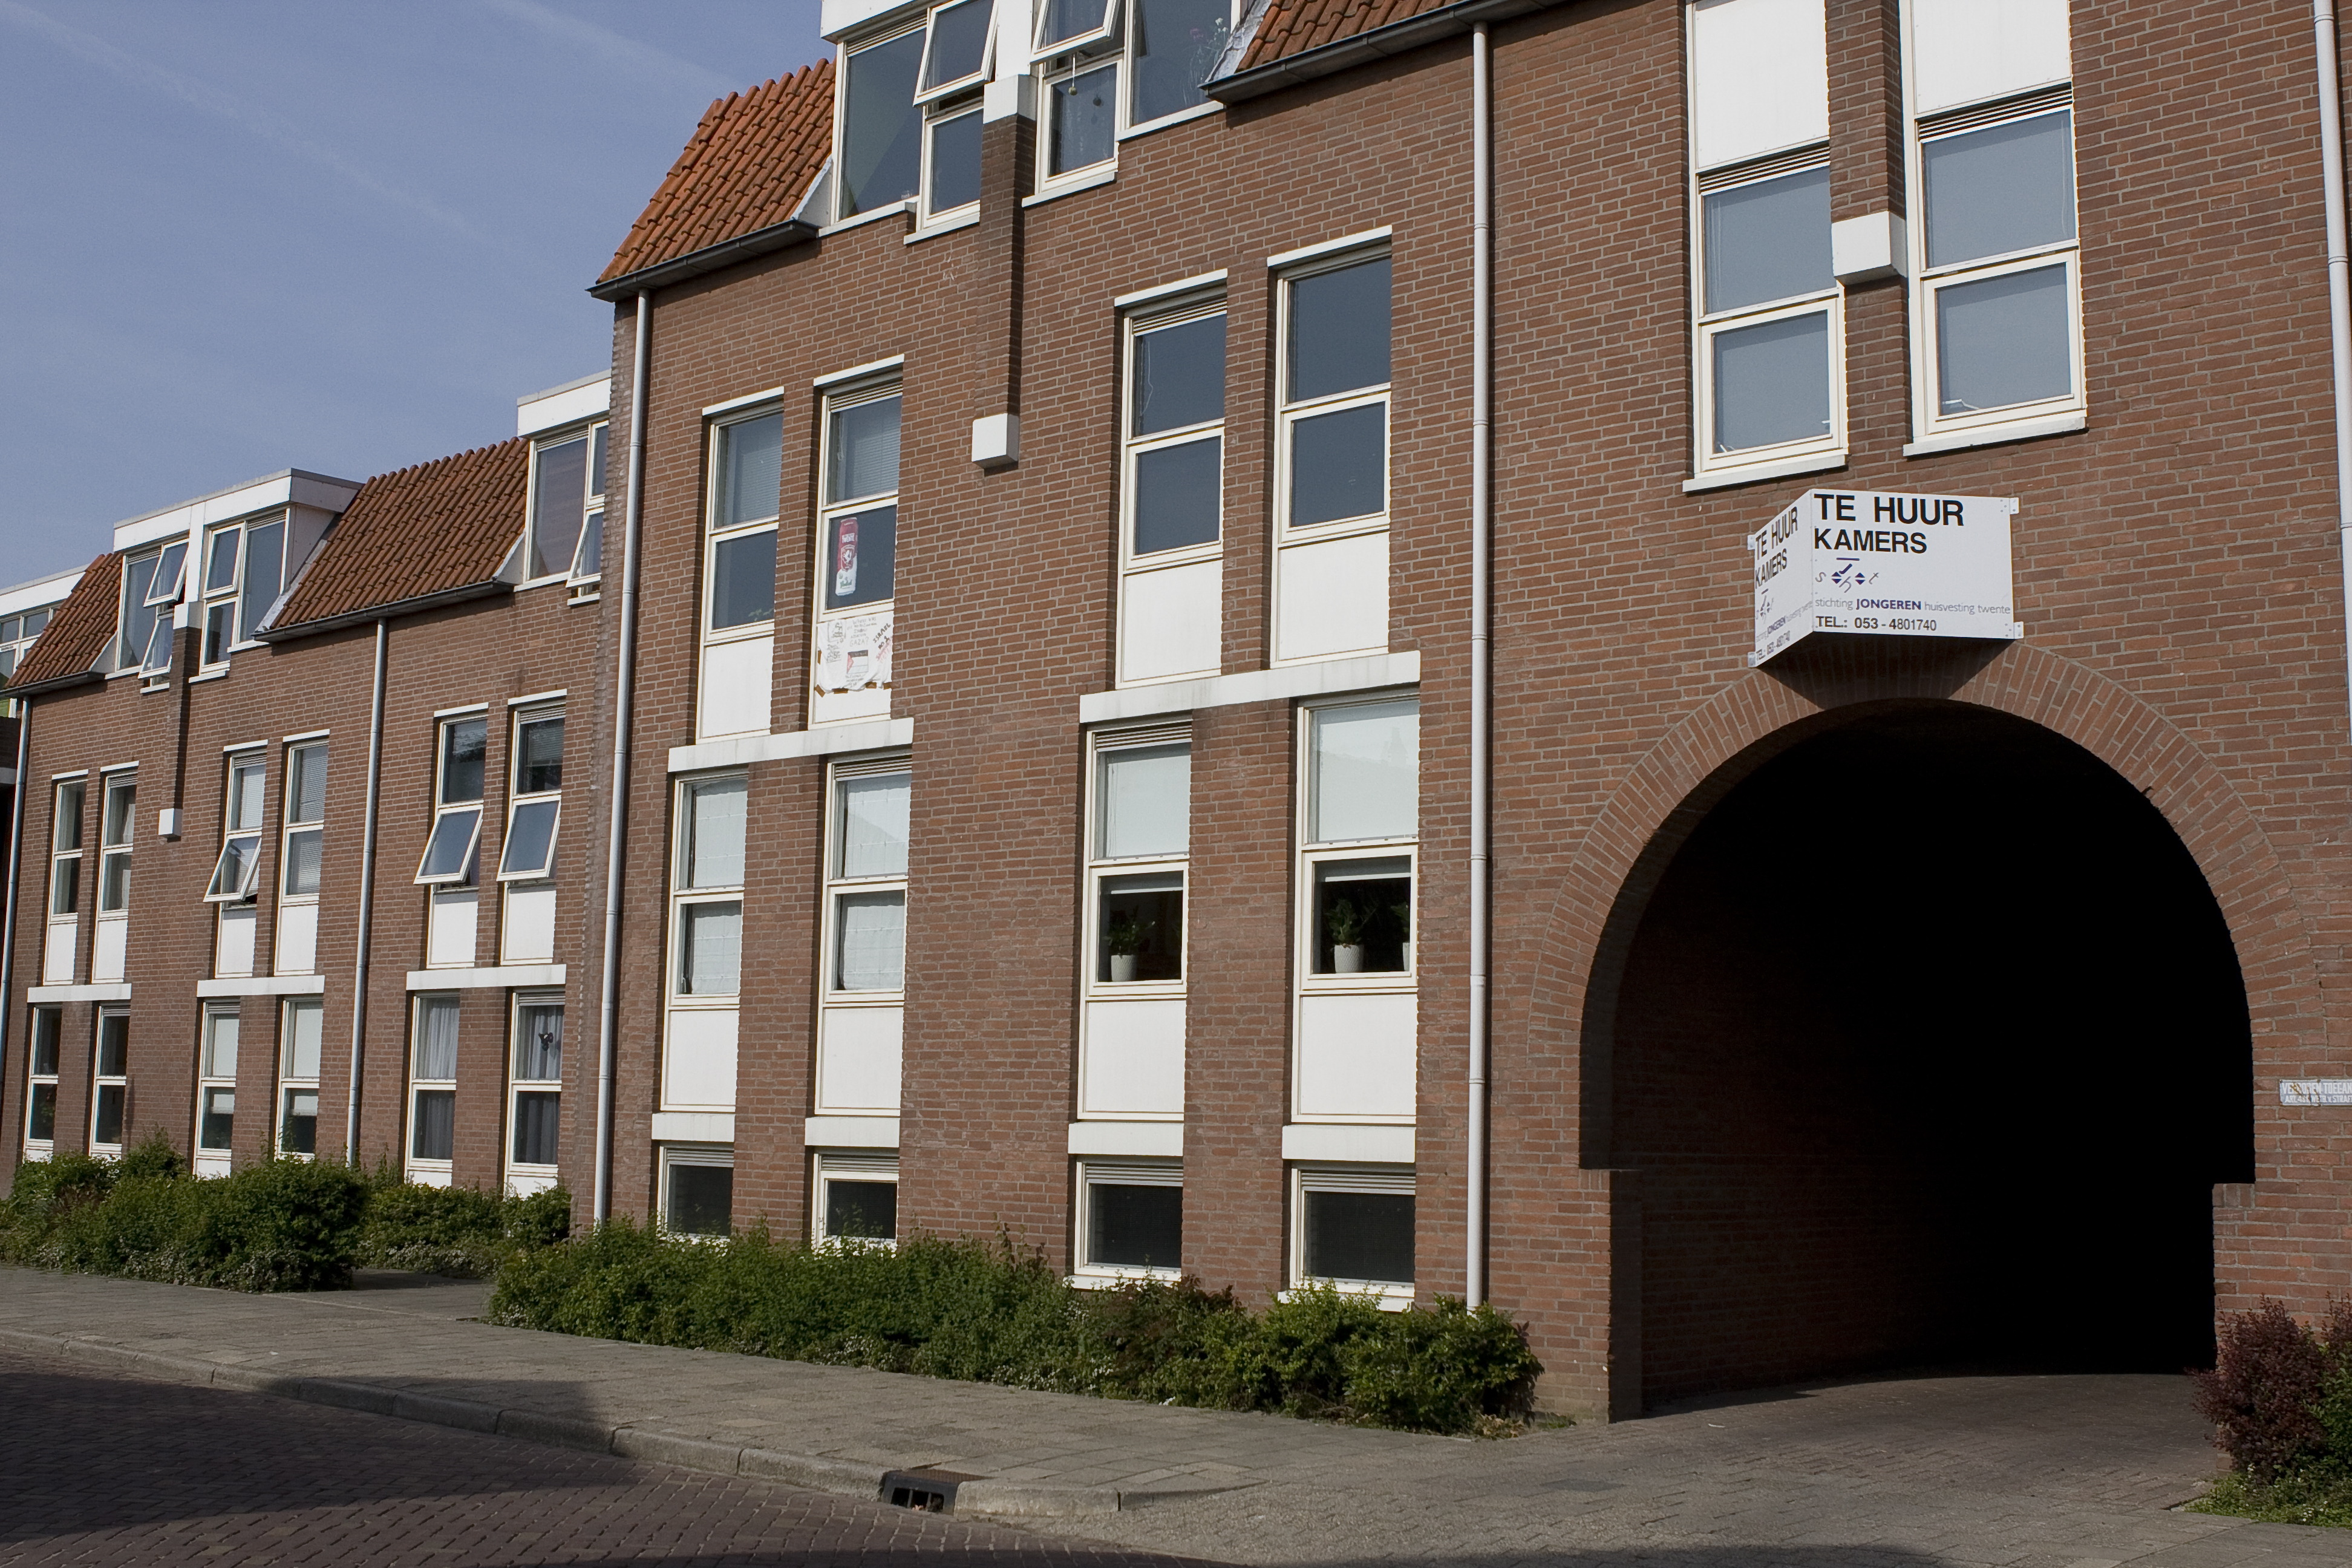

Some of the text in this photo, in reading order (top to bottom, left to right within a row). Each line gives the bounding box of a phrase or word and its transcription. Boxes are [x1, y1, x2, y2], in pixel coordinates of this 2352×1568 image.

[1814, 494, 1964, 526] TE HUUR
[1756, 506, 1798, 560] TE HUUR
[1814, 528, 1927, 554] KAMERS
[1755, 548, 1787, 589] KAMERS
[1815, 597, 2011, 615] stichting JONGEREN huisvesting twente
[1854, 617, 1879, 629] 053
[1889, 618, 1936, 631] 4801740
[849, 636, 869, 647] GAZA?
